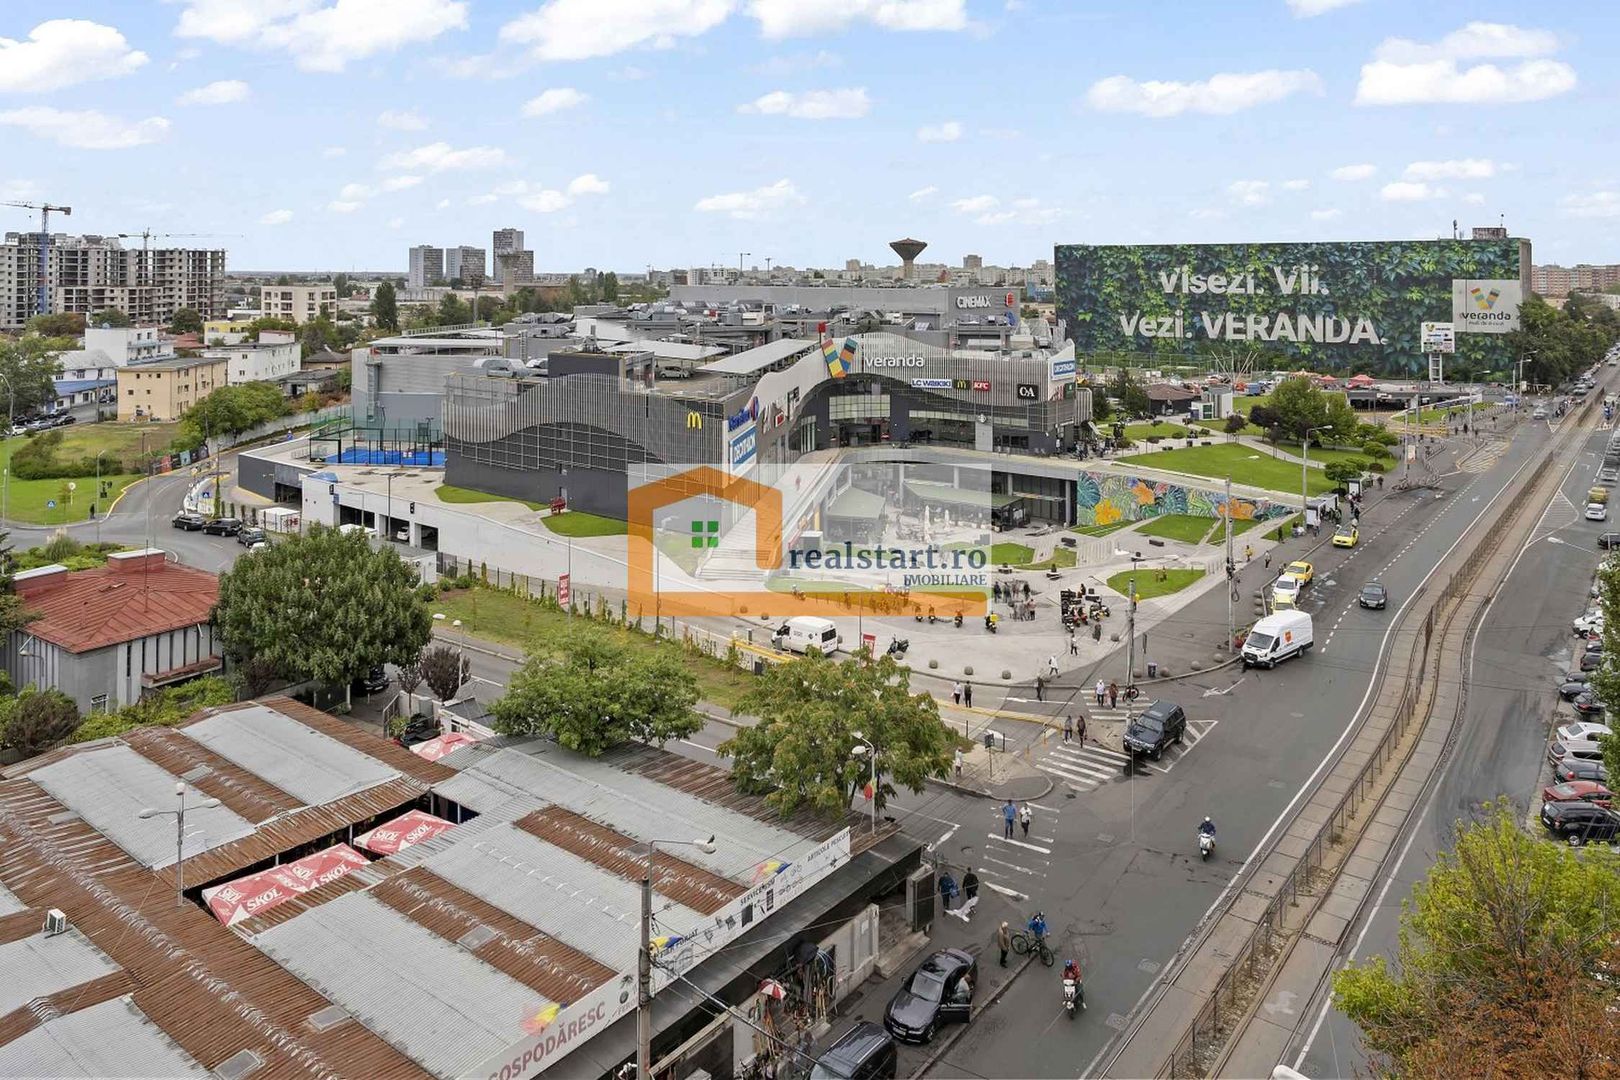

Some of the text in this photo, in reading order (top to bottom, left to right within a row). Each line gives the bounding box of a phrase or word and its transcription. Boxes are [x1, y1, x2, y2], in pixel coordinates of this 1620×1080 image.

[956, 294, 992, 310] CINEMAX
[1460, 311, 1512, 321] veranda
[1119, 308, 1193, 339] Vezi.
[1200, 310, 1388, 346] VERANDA.
[864, 353, 925, 368] veranda
[911, 379, 951, 388] LC WAIKIKI
[973, 382, 990, 390] KFC
[406, 823, 432, 844] SKOL
[319, 863, 351, 884] SKOL
[246, 888, 283, 912] SKOL
